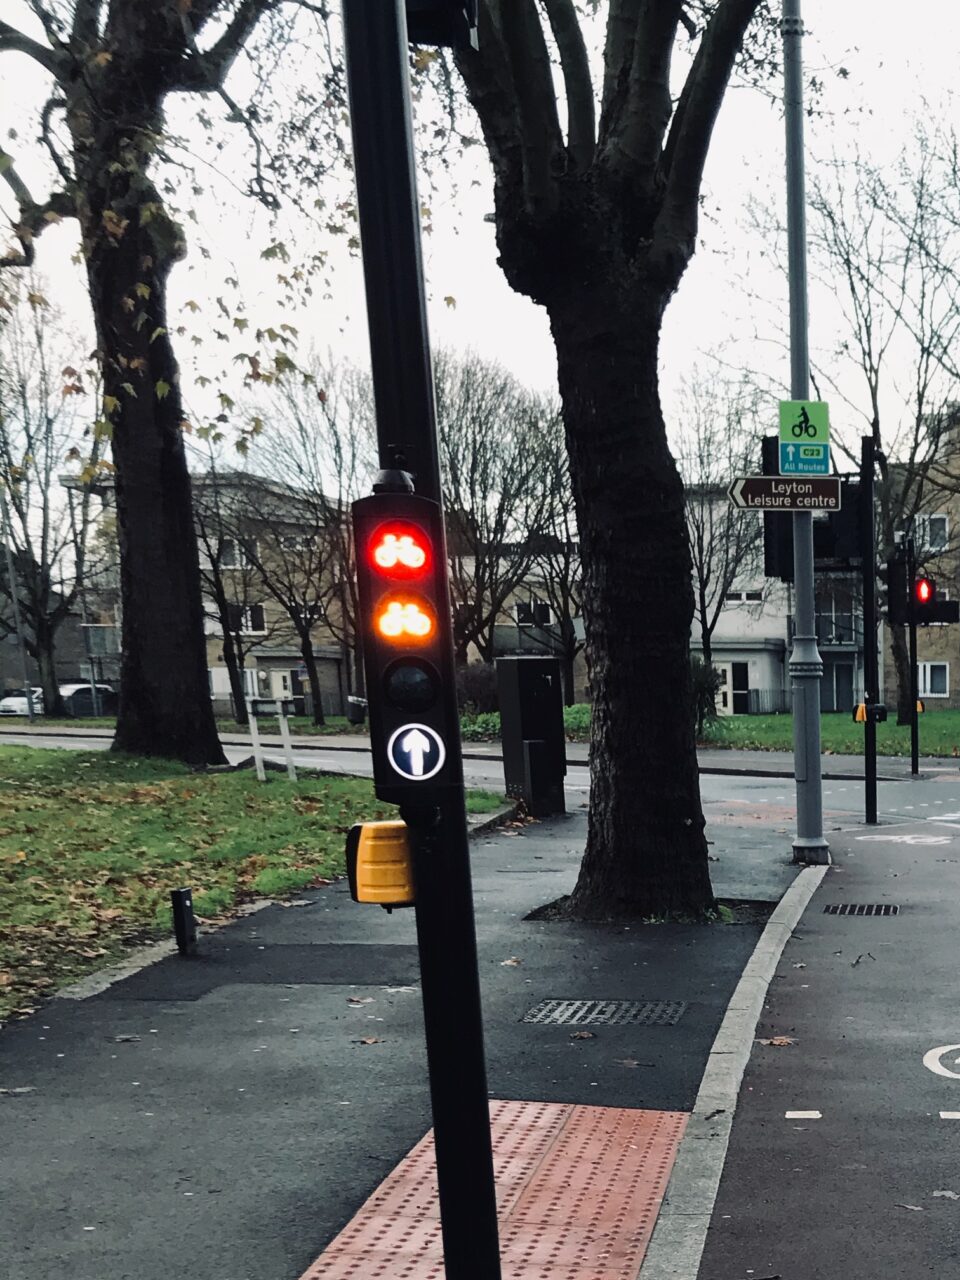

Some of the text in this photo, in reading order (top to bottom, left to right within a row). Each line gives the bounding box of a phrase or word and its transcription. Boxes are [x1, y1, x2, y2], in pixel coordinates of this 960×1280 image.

[803, 449, 821, 457] C23
[784, 463, 826, 471] All Routes
[771, 481, 813, 495] Leyton
[748, 494, 837, 507] Leisure centre
